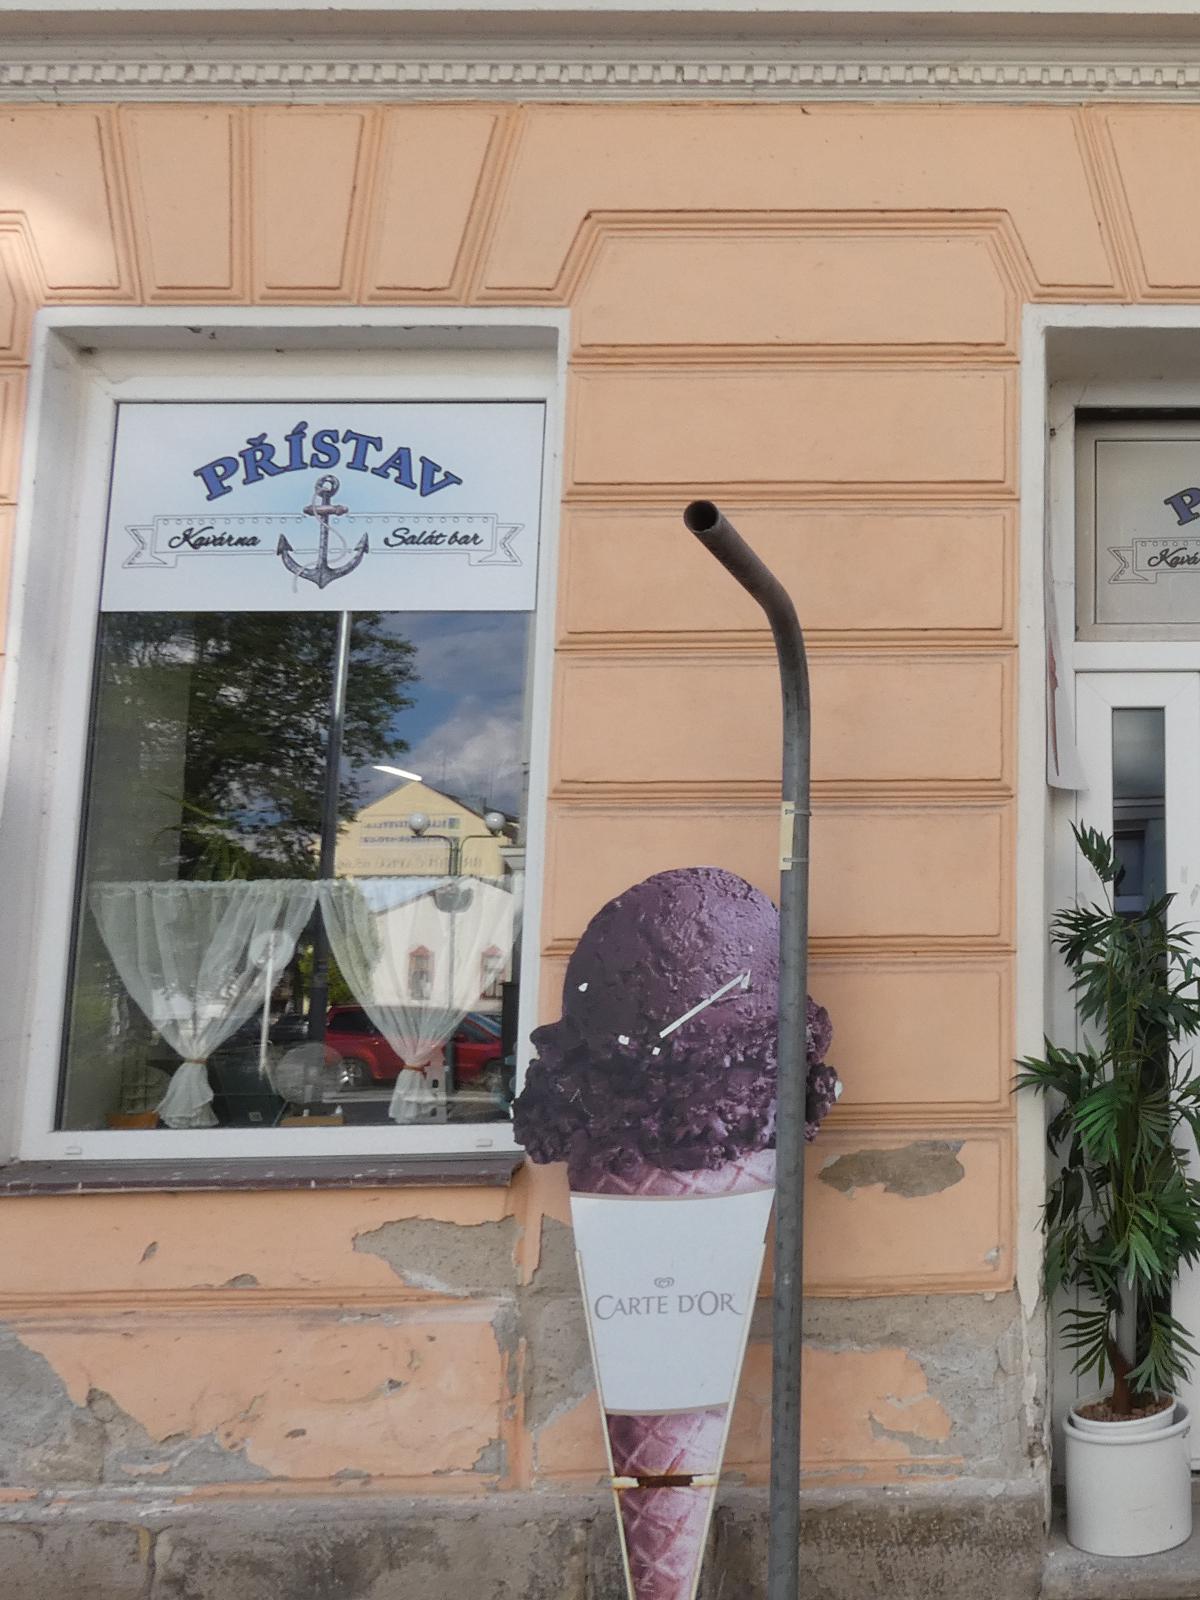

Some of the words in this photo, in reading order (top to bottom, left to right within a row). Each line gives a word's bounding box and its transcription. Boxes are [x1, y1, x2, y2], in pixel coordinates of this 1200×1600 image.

[193, 420, 462, 501] PŘÍSTAV
[168, 526, 261, 549] Kavárna
[383, 527, 447, 548] Salát
[447, 529, 483, 547] bar
[594, 1294, 669, 1320] CARTE
[678, 1290, 743, 1316] D'OR
